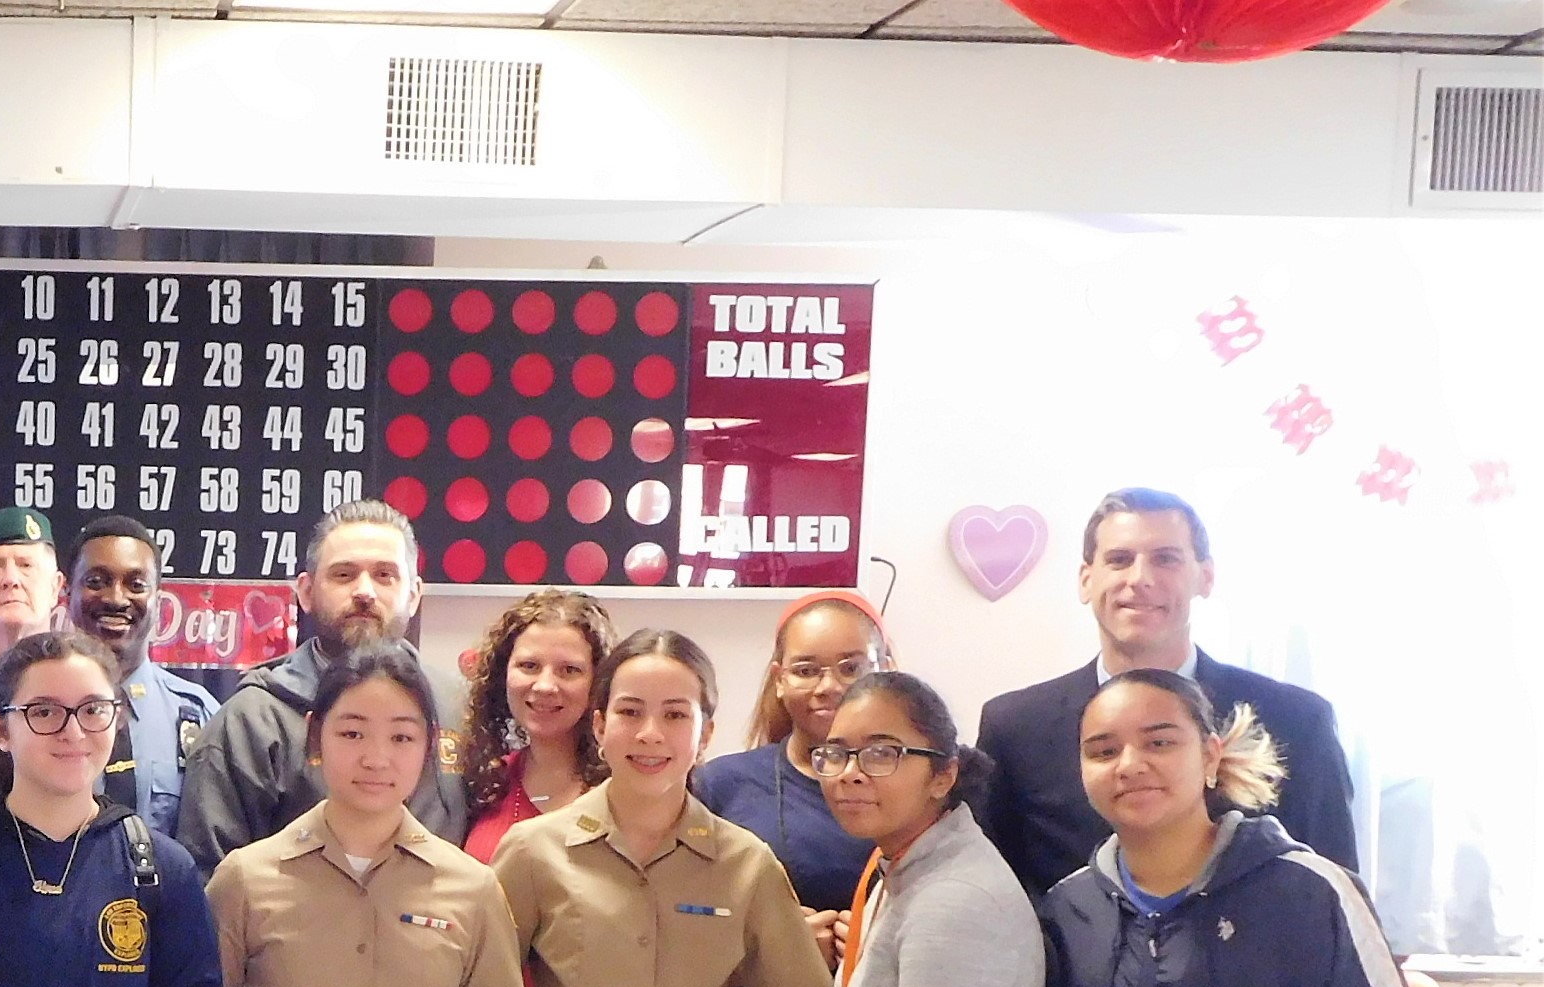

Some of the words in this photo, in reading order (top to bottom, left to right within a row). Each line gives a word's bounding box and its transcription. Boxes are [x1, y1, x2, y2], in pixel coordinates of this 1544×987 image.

[21, 275, 55, 321] 10
[86, 277, 114, 322] 11
[145, 278, 180, 323] 12
[207, 279, 242, 325] 13
[269, 281, 304, 326] 14
[331, 282, 366, 328] 15
[709, 295, 846, 335] TOTAL
[17, 338, 56, 384] 25
[78, 340, 119, 386] 26
[141, 341, 180, 387] 27
[203, 343, 243, 388] 28
[265, 344, 305, 389] 29
[326, 345, 367, 391] 30
[706, 341, 845, 379] BALLS
[16, 401, 56, 446] 40
[81, 402, 115, 448] 41
[139, 403, 180, 449] 42
[201, 405, 242, 451] 43
[262, 406, 303, 452] 44
[324, 407, 365, 453] 45
[14, 463, 54, 509] 55
[76, 465, 116, 510] 56
[139, 466, 177, 512] 57
[199, 468, 239, 513] 58
[261, 469, 301, 514] 59
[323, 469, 363, 514] 60
[153, 527, 175, 574] 2
[199, 530, 237, 575] 73
[260, 531, 298, 577] 74
[696, 515, 851, 553] CALLED
[152, 590, 238, 657] Day
